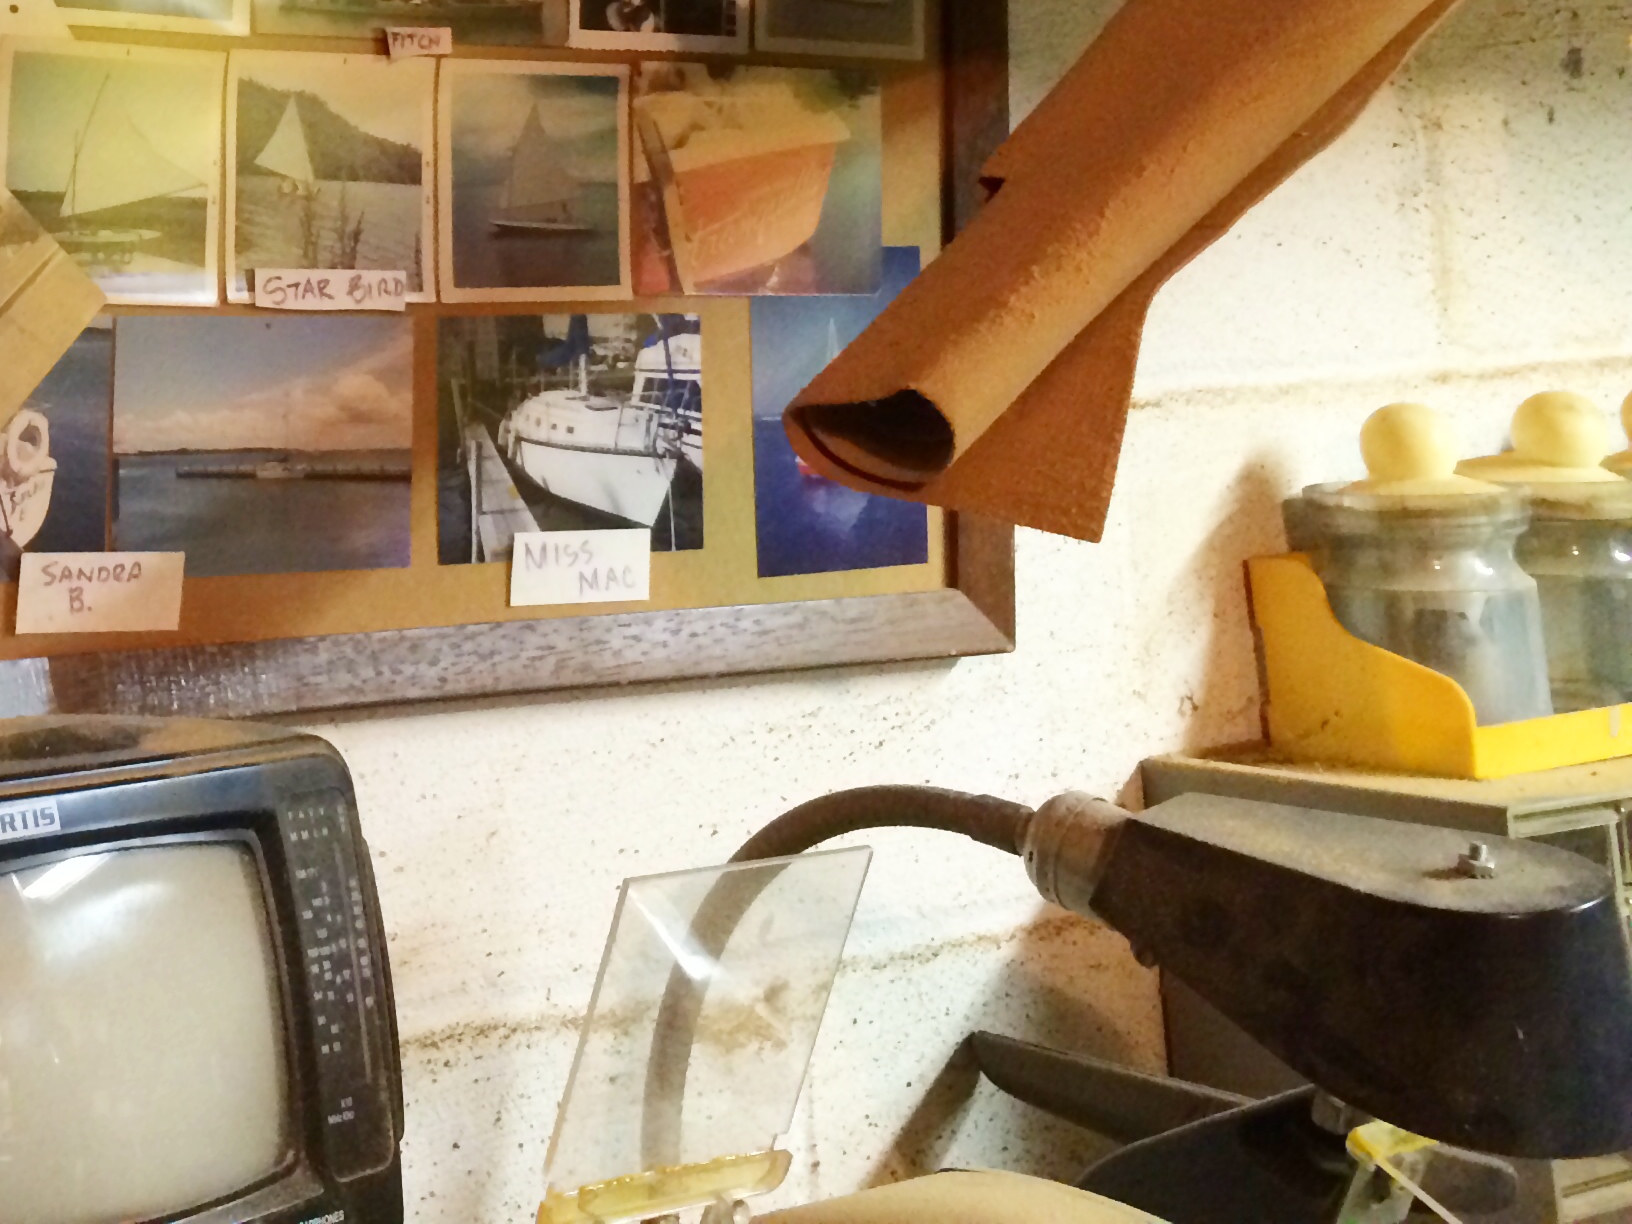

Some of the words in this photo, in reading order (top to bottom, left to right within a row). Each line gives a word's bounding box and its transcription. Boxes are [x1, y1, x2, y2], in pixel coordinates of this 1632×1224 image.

[262, 275, 336, 306] STAR
[346, 273, 405, 305] BIRD
[523, 538, 595, 572] MISS
[40, 560, 143, 587] SANDRA
[577, 564, 637, 598] MAC
